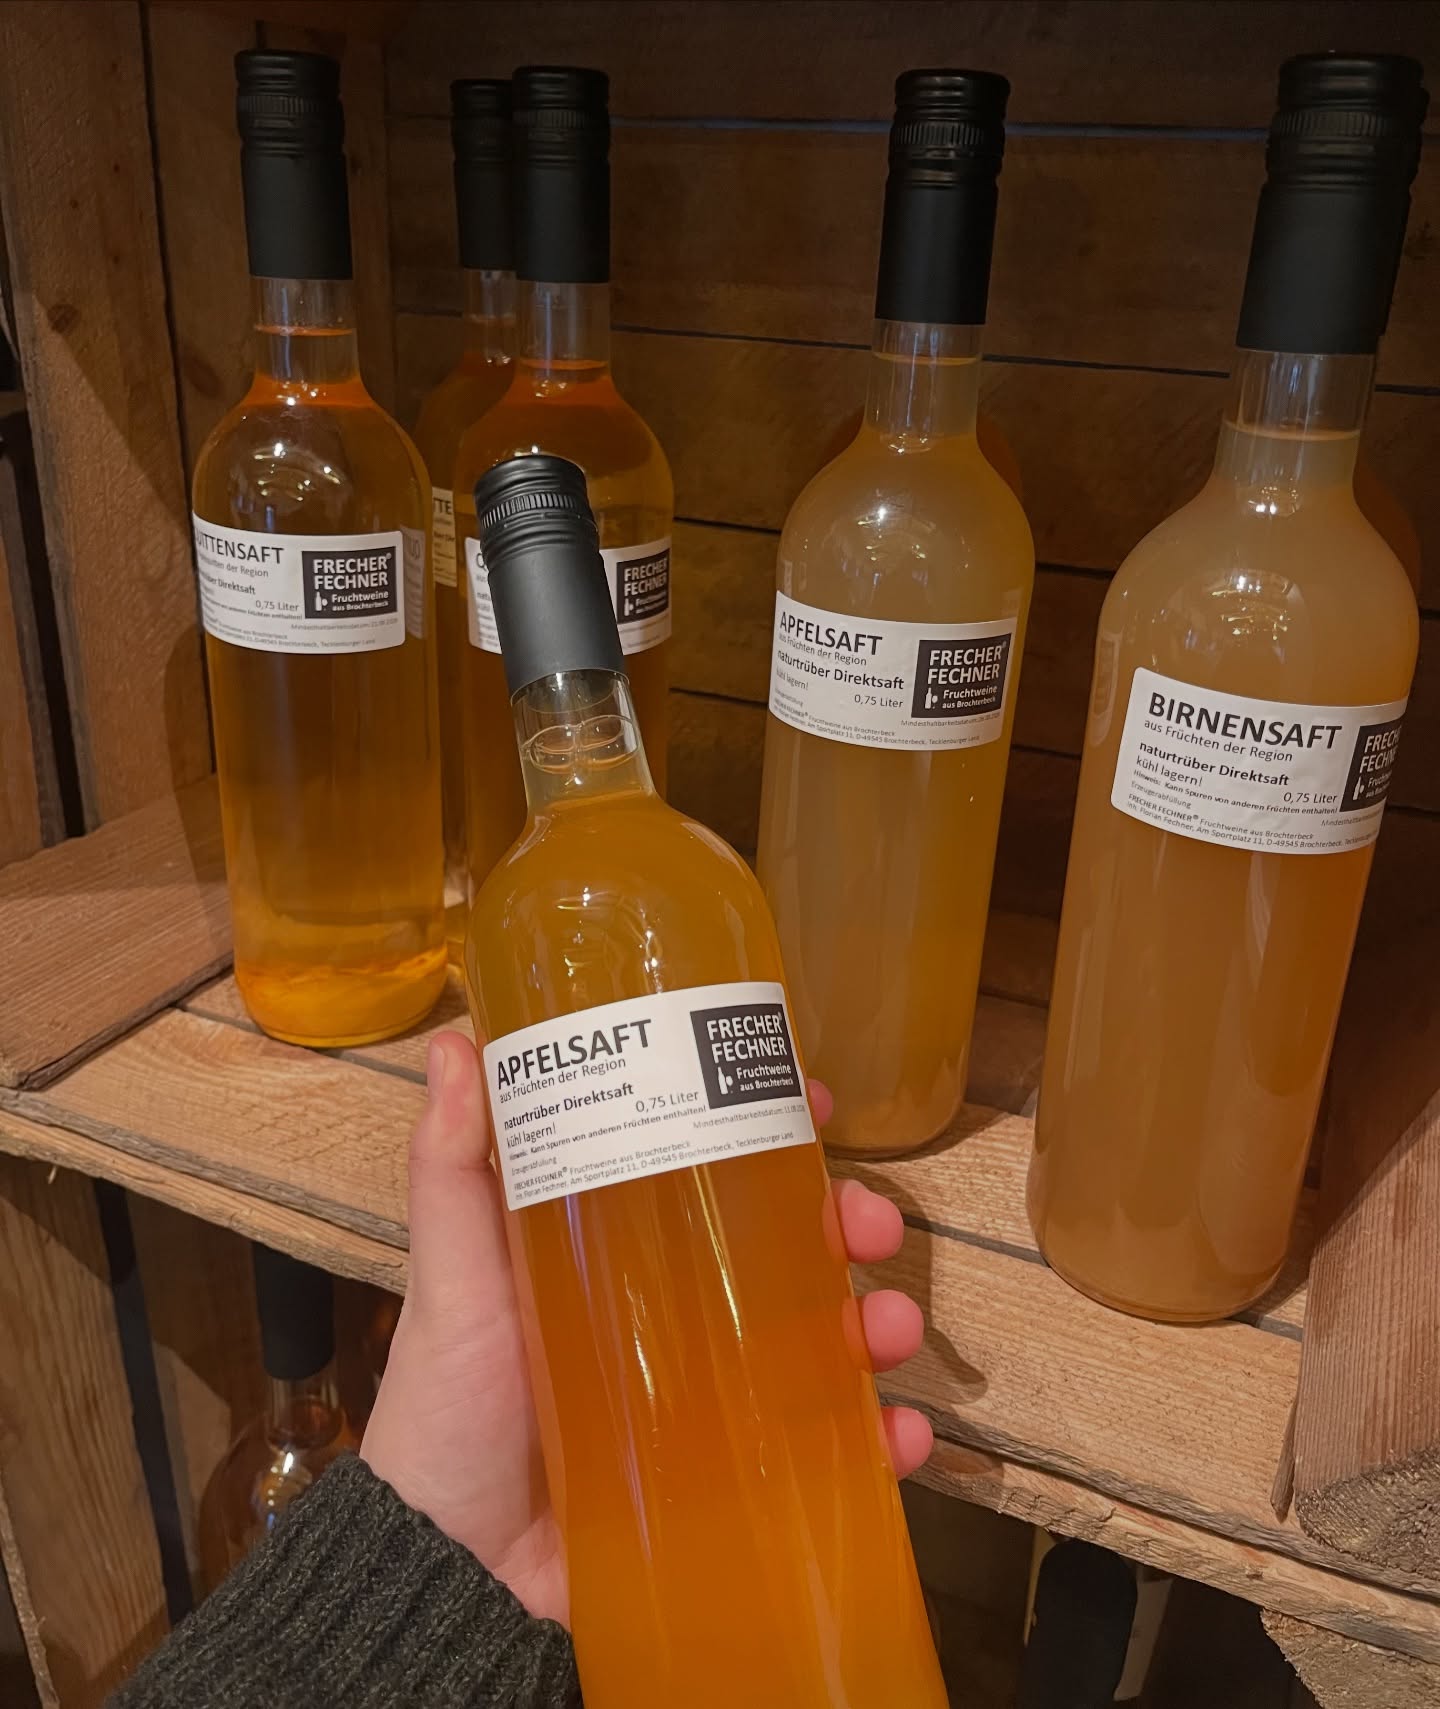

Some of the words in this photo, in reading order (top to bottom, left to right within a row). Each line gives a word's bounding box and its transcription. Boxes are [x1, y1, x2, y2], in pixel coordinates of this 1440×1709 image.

[241, 566, 268, 577] Region
[314, 572, 388, 590] FECHNER
[219, 578, 255, 595] Direktsaft
[332, 591, 388, 603] Fruchtweine
[256, 600, 275, 610] 0,75
[278, 601, 299, 611] Liter
[346, 600, 388, 610] Brochterbeck
[780, 611, 883, 655] APFELSAFT
[787, 636, 815, 655] Früchten
[818, 648, 831, 659] der
[835, 652, 867, 666] Region
[778, 650, 830, 678] naturtrüber
[834, 669, 904, 689] Direktsaft
[927, 664, 999, 684] FECHNER
[854, 694, 876, 705] 0,75
[880, 698, 903, 708] Liter
[943, 685, 997, 699] Fruchtweine
[957, 696, 995, 708] Brochterbeck
[1149, 692, 1342, 749] BIRNENSAFT
[1144, 719, 1162, 732] aus
[1165, 726, 1219, 749] Früchten
[1224, 742, 1246, 755] der
[1249, 746, 1293, 762] Region
[1136, 756, 1158, 772] kühl
[1161, 763, 1203, 787] lagern!
[1139, 742, 1216, 773] naturtrüber
[1219, 764, 1289, 786] Direktsaft
[1164, 782, 1183, 793] Kann
[1185, 788, 1212, 800] Spuren
[1214, 796, 1229, 805] von
[1231, 800, 1265, 811] anderen
[1266, 804, 1300, 814] Früchten
[1283, 792, 1310, 804] 0,75
[1313, 793, 1338, 804] Liter
[1200, 819, 1248, 834] Fruchtweine
[1265, 830, 1314, 840] Brochterbeck
[1211, 828, 1251, 842] Sportplatz
[1267, 838, 1299, 848] D-49545
[498, 1019, 651, 1090] APFELSAFT
[711, 1037, 788, 1064] FECHNER
[500, 1092, 512, 1104] aus
[513, 1076, 554, 1099] Früchten
[558, 1070, 577, 1084] der
[582, 1058, 626, 1076] Region
[736, 1062, 792, 1079] Fruchtweine
[755, 1077, 793, 1089] Brochterbeck
[504, 1103, 560, 1131] naturtrüber
[564, 1083, 634, 1111] Direktsaft
[636, 1096, 666, 1113] 0,75
[670, 1091, 699, 1105] Liter
[507, 1135, 522, 1148] kühl
[523, 1122, 556, 1143] lagern!
[546, 1138, 571, 1150] Spuren
[572, 1134, 586, 1142] von
[588, 1124, 622, 1138] anderen
[623, 1115, 661, 1129] Früchten
[664, 1105, 707, 1120] enthalten!
[570, 1157, 617, 1175] Fruchtweine
[619, 1155, 633, 1163] aus
[635, 1141, 690, 1159] Brochterbeck
[570, 1176, 583, 1185] Am
[584, 1167, 624, 1182] Sportplatz
[679, 1142, 734, 1160] Brochterbeck,
[736, 1135, 781, 1148] Tecklenburger
